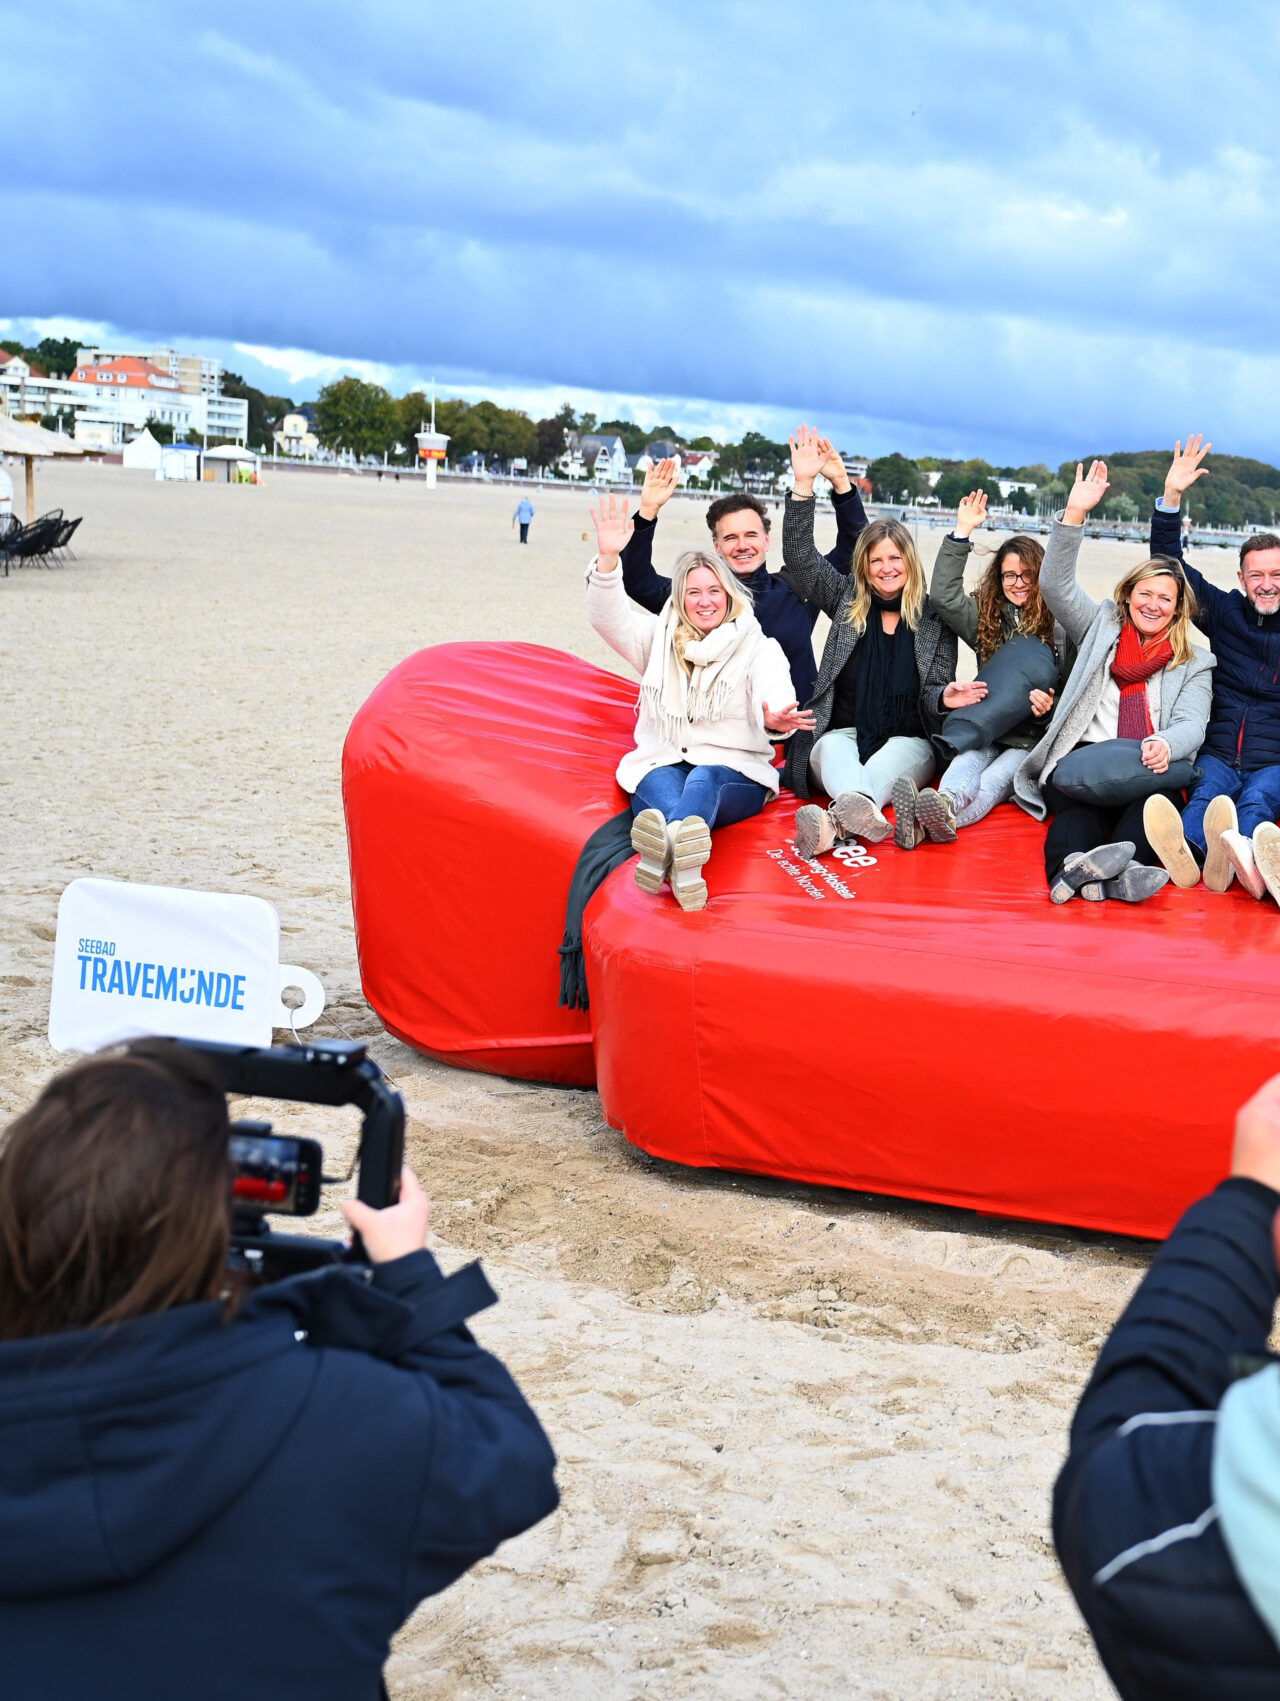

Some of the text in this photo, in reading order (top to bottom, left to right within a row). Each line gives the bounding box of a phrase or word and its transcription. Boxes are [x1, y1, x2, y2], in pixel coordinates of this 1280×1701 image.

[777, 859, 802, 876] echte
[794, 874, 826, 900] Norden
[78, 938, 116, 957] SEEBAD
[77, 955, 246, 1010] TRAVEMÜNDE
